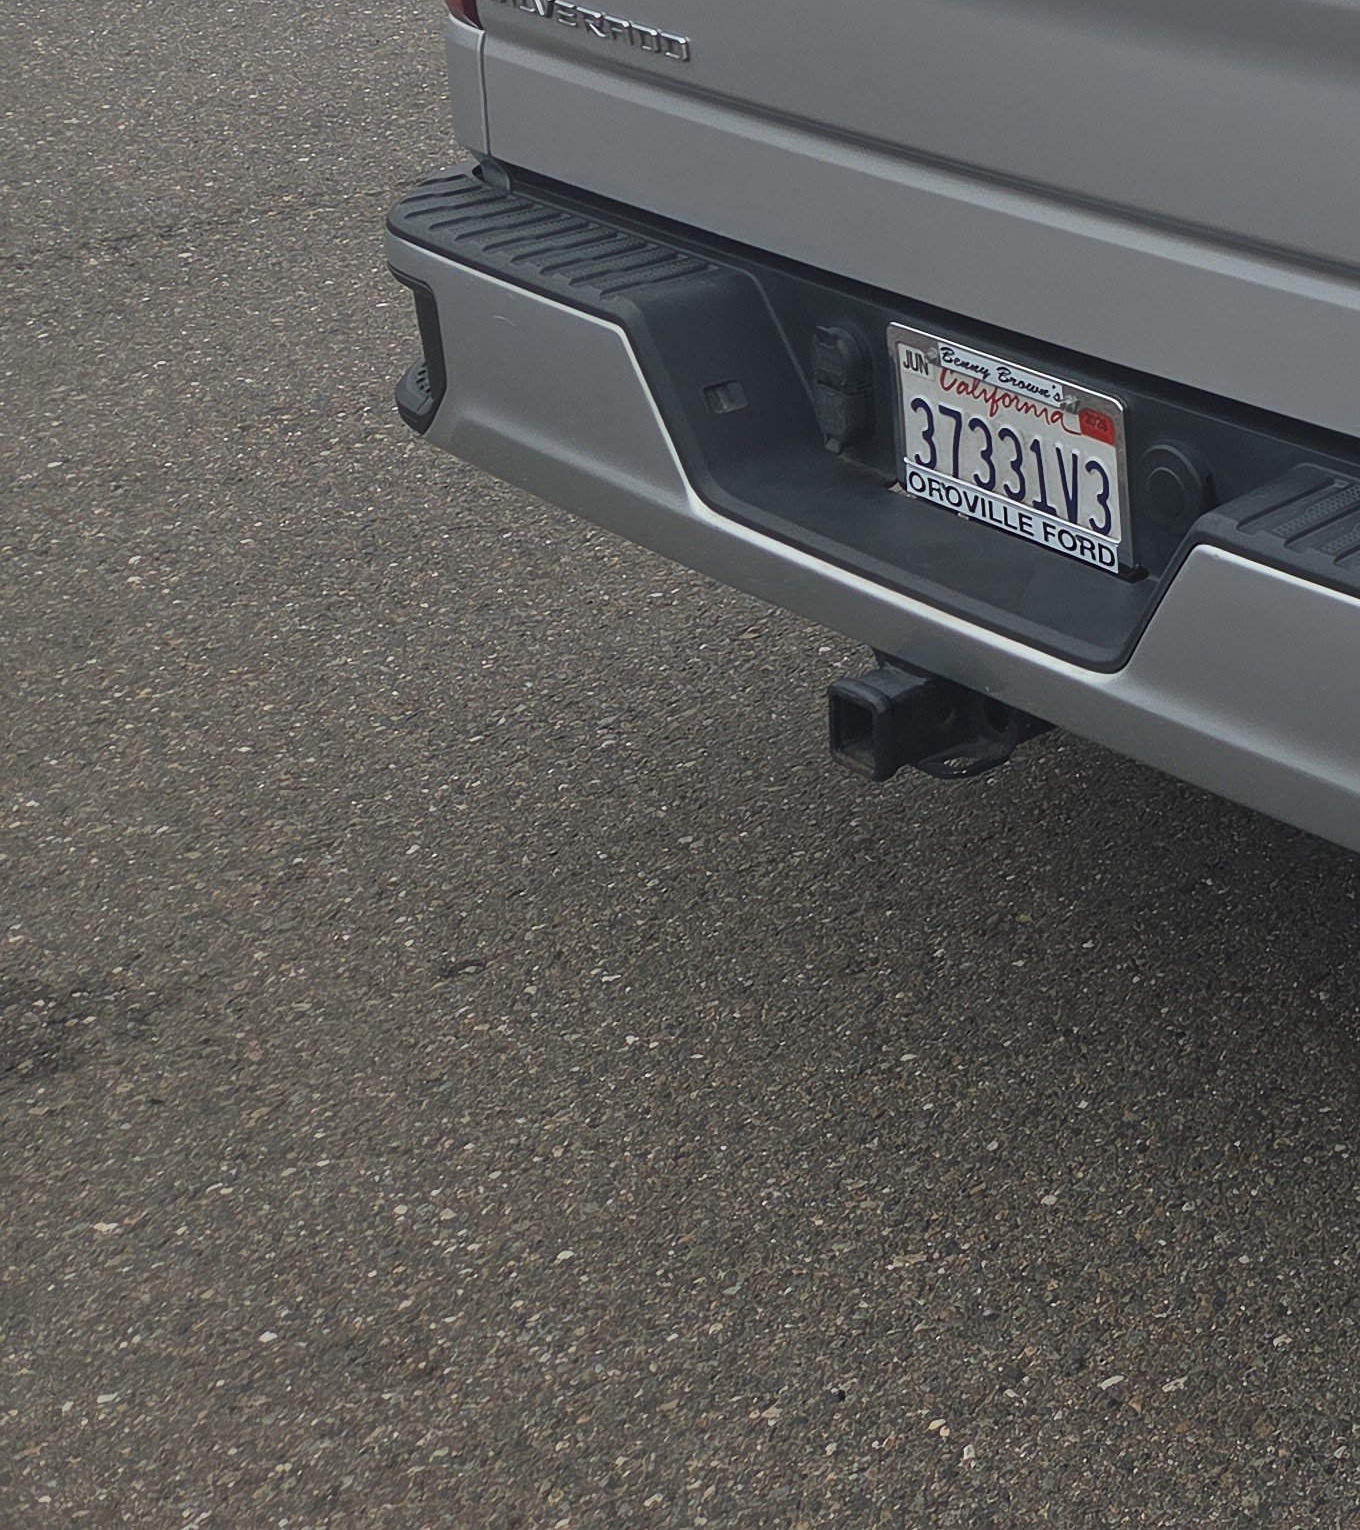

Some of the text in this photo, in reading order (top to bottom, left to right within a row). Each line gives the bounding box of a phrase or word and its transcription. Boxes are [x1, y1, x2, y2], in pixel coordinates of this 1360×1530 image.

[903, 349, 930, 376] JUN
[940, 346, 1061, 402] Benny Brown's
[940, 367, 1082, 436] California
[910, 397, 1112, 536] 37331V3
[908, 471, 1116, 568] OROVILLE FORD
